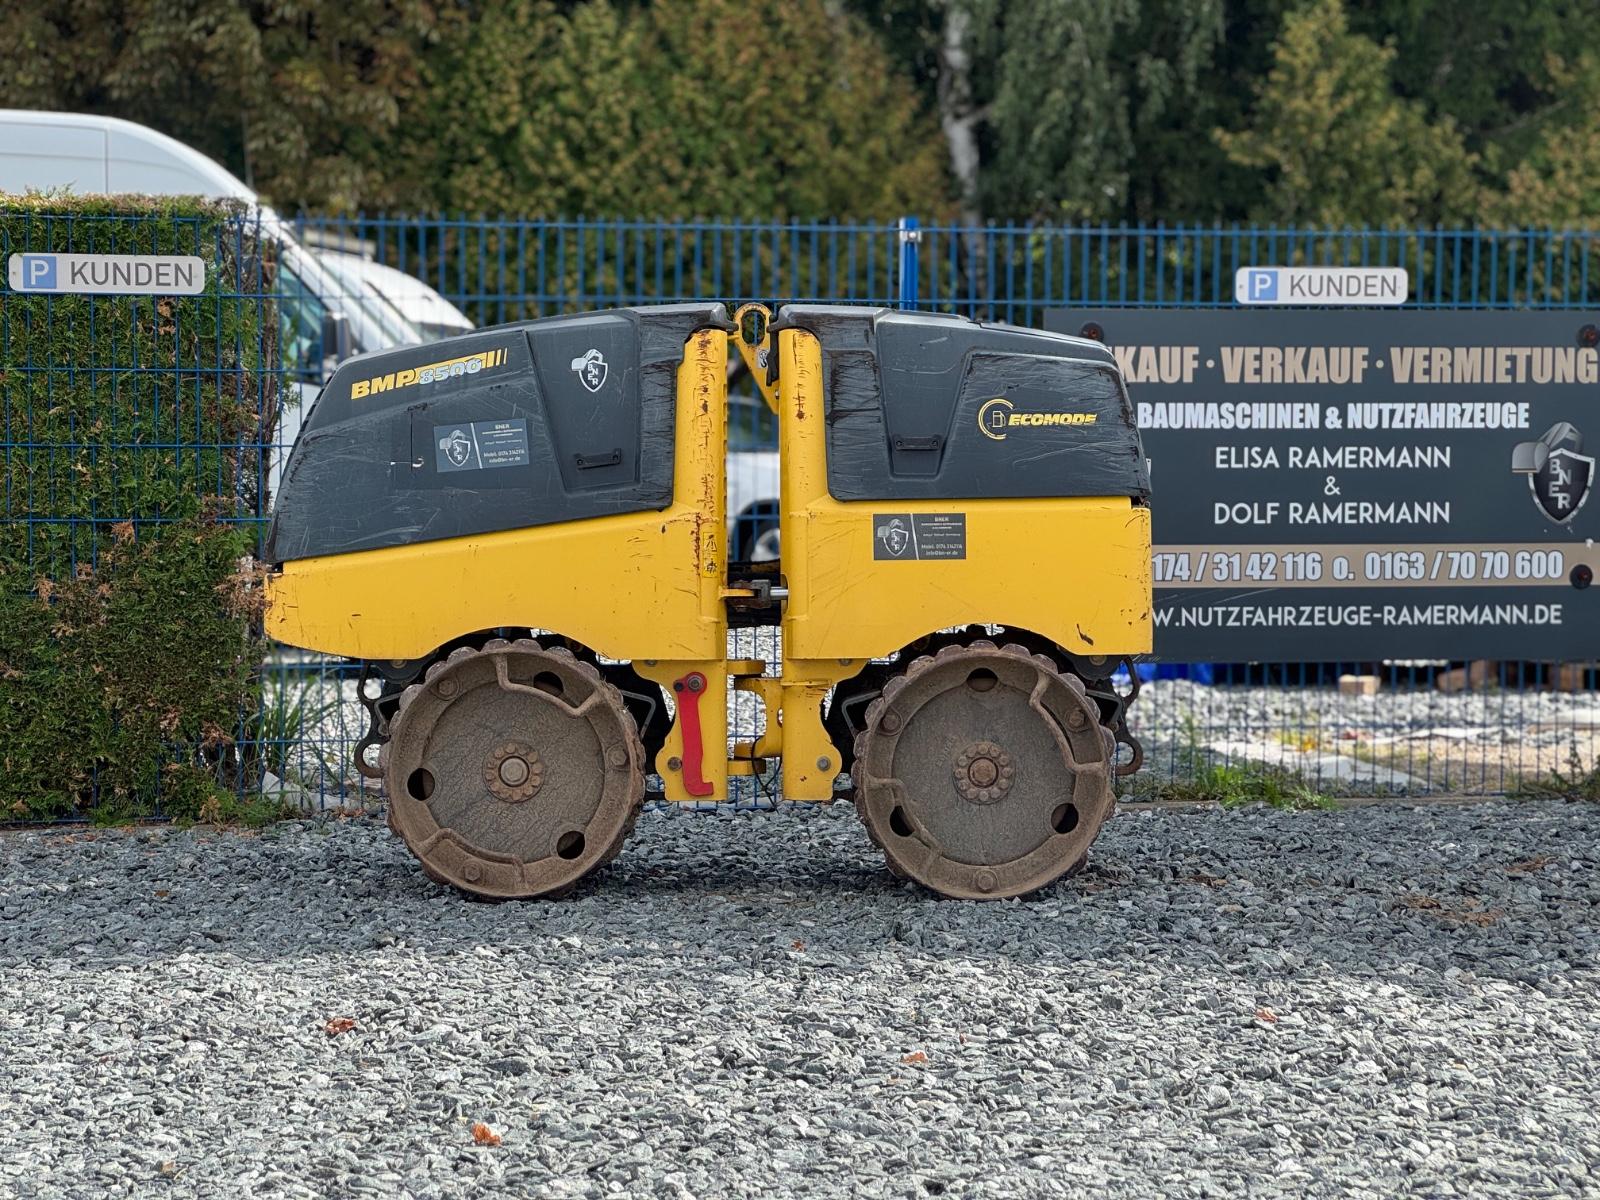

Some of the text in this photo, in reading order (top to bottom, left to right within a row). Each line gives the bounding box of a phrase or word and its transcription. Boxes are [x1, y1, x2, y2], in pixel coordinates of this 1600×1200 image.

[30, 259, 193, 287] P KUNDEN
[1255, 274, 1397, 298] P KUNDEN
[1108, 346, 1599, 384] KAUF VERKAUF VERMIETUNG
[1008, 413, 1098, 426] ECOMODE
[1137, 402, 1530, 430] BAUMASCHINEN & NUTZFAHRZEUGE
[1215, 446, 1451, 469] ELISA RAMERMANN
[1323, 475, 1341, 496] &
[1214, 501, 1450, 524] DOLF RAMERMANN
[1194, 552, 1209, 582] /
[1212, 552, 1241, 581] 31
[1245, 552, 1277, 581] 42
[1281, 551, 1323, 581] 116
[1364, 551, 1425, 580] 0163
[1429, 551, 1444, 580] /
[1447, 550, 1477, 580] 70
[1481, 550, 1510, 580] 70
[1514, 550, 1564, 579] 600
[1152, 604, 1563, 627] W.NUTZFAHRZEUGE-RAMERMANN.DE
